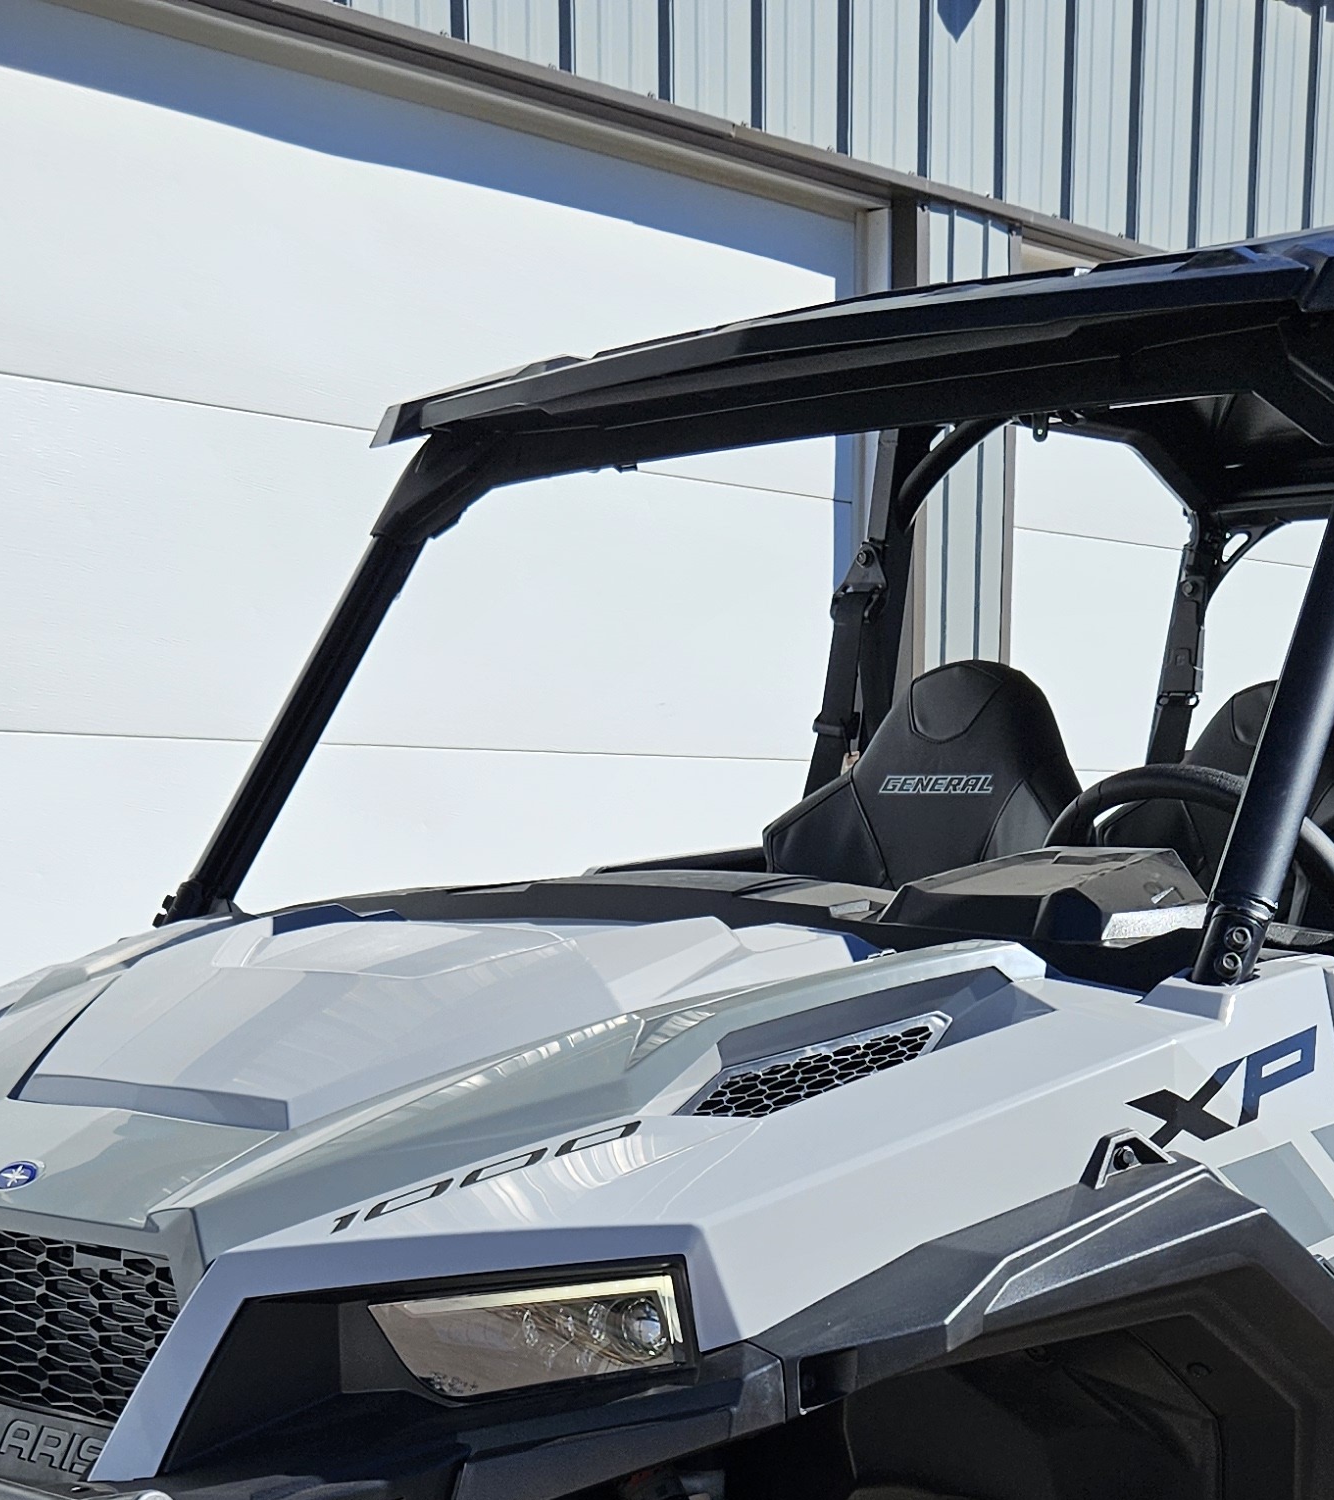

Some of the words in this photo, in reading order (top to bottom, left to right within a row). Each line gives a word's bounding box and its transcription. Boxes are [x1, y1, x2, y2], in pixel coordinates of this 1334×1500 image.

[878, 774, 994, 794] GENERAL
[1125, 1024, 1317, 1148] XP
[330, 1120, 642, 1234] 1000
